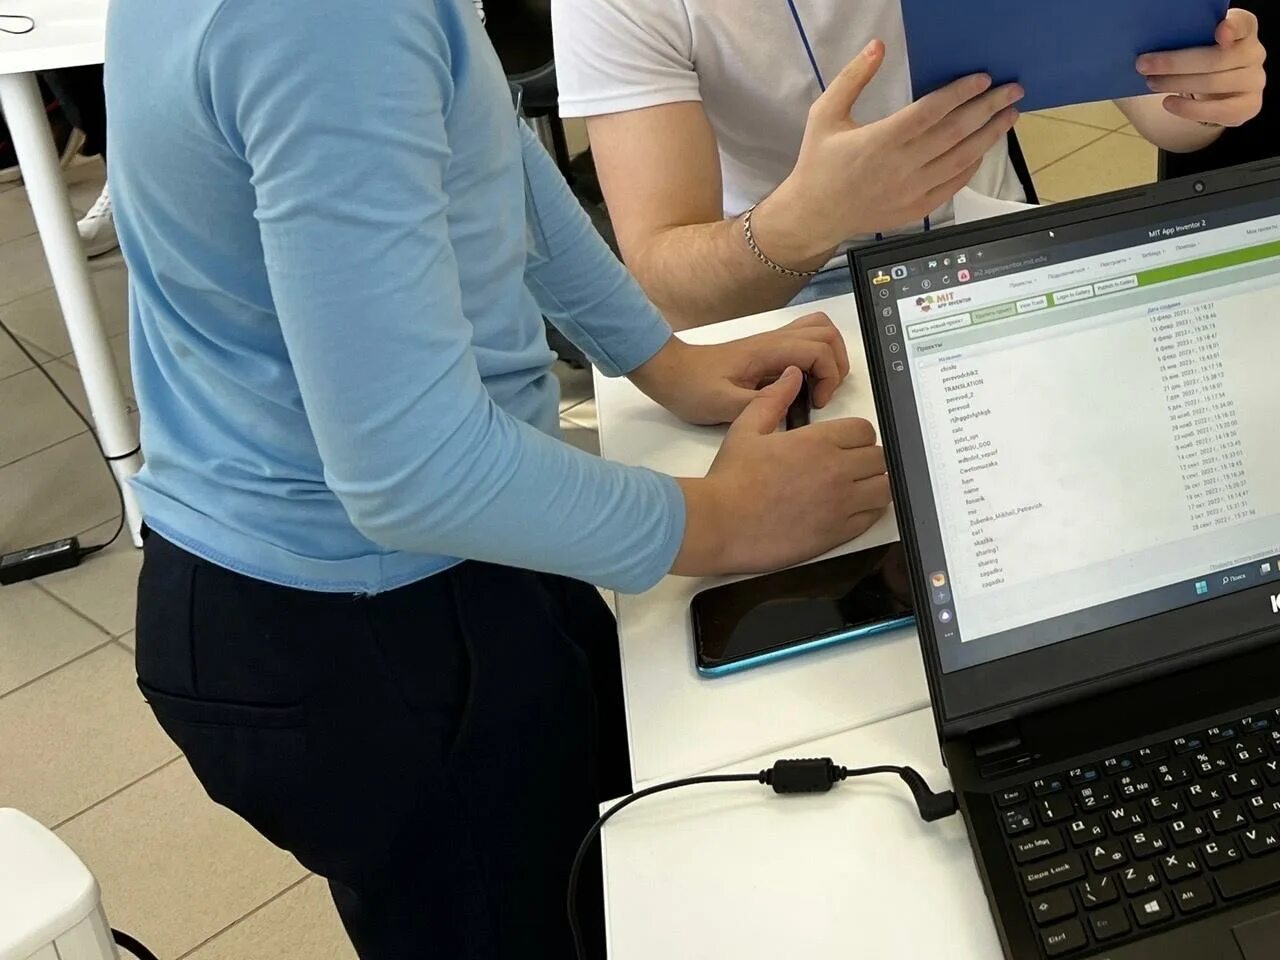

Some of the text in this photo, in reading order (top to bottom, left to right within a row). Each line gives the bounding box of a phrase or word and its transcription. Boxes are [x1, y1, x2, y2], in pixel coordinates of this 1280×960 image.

[1149, 219, 1206, 238] MIT App Inventor 2
[937, 292, 955, 303] MIT
[917, 343, 943, 353] Проекты
[944, 379, 984, 393] TRANSLATION
[1028, 864, 1070, 880] Caps Lock
[1049, 933, 1065, 943] Ctrl
